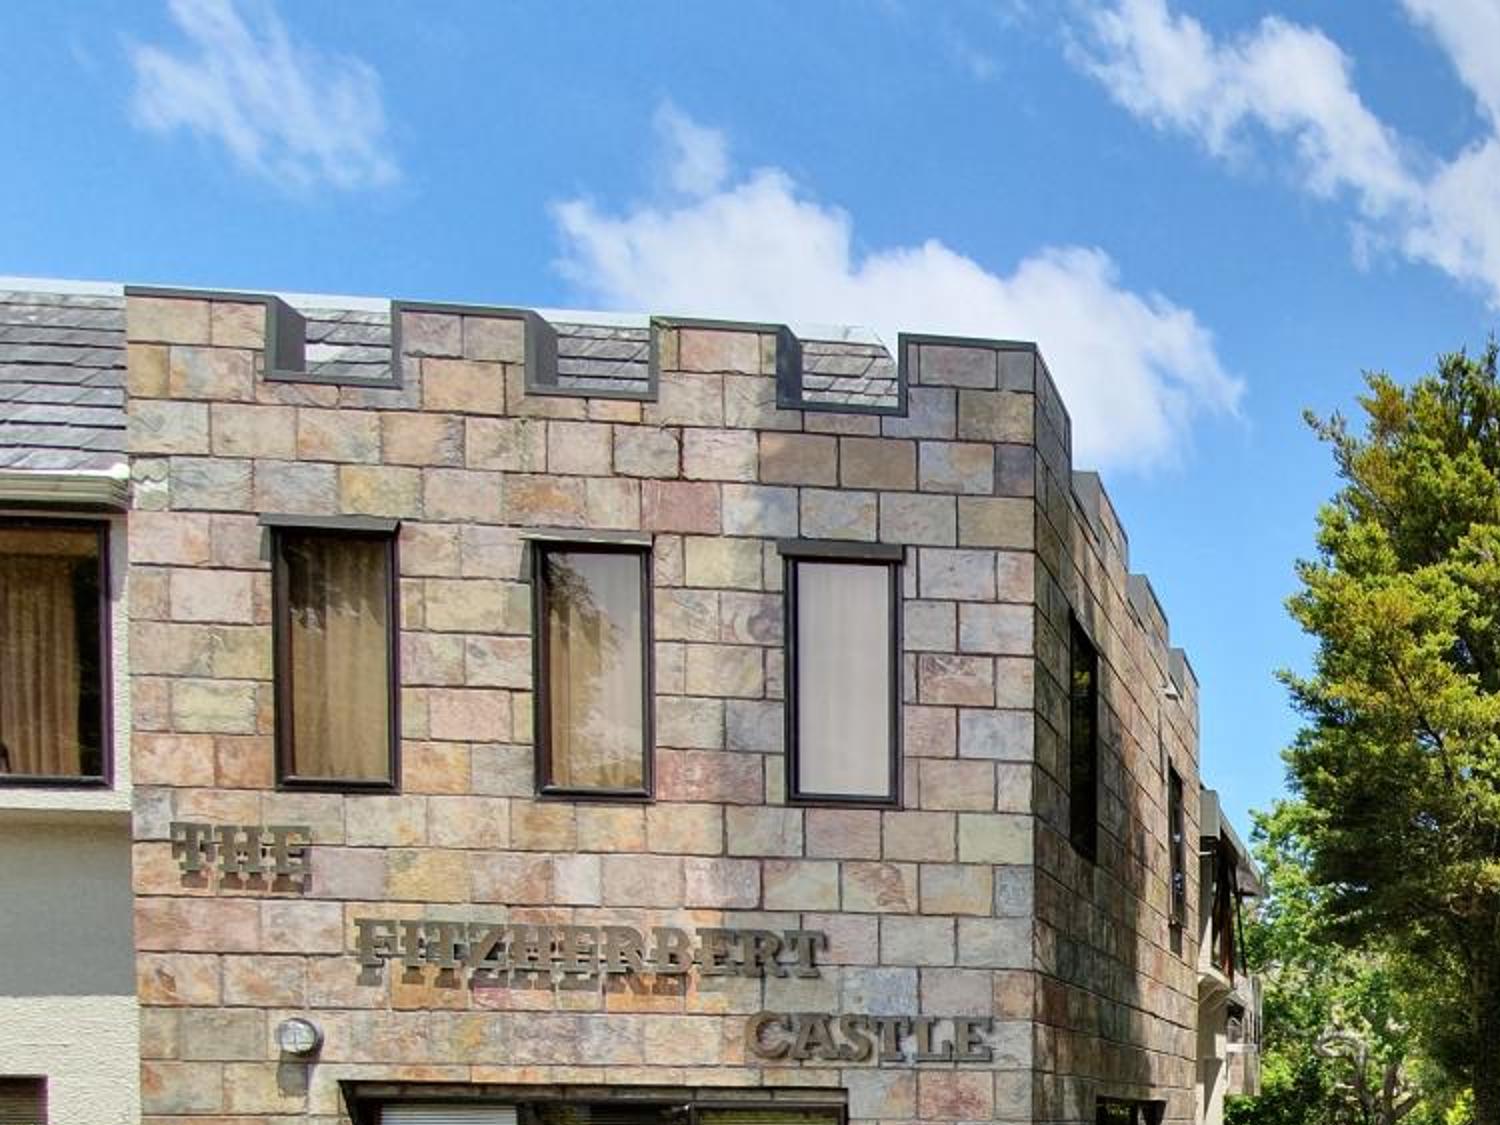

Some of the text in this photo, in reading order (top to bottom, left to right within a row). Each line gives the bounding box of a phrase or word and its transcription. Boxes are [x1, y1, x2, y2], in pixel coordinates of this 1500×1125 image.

[169, 822, 312, 873] THE
[353, 918, 829, 979] FITZHERBERT
[744, 1010, 994, 1063] CASTLE
